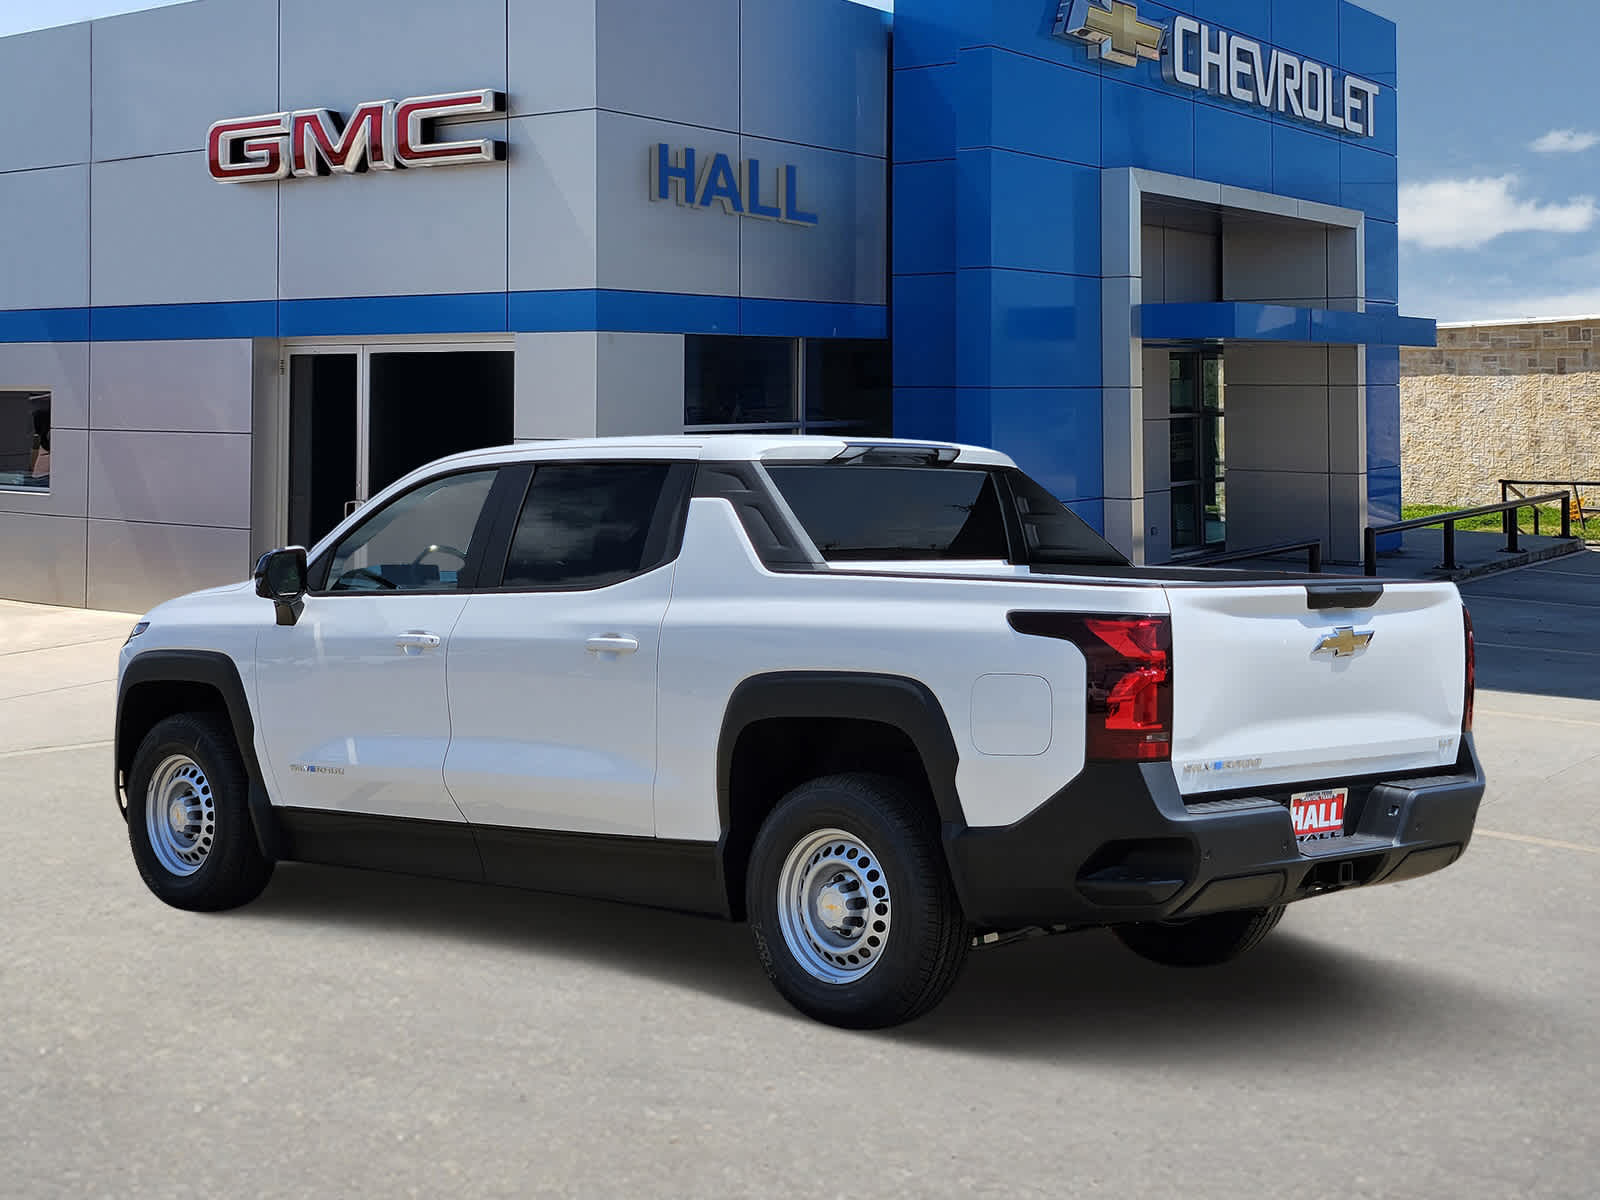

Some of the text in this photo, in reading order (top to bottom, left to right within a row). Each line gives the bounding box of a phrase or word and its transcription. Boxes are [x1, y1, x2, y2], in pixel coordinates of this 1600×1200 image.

[1173, 15, 1379, 137] CHEVROLET
[206, 88, 507, 184] GMC
[650, 142, 818, 227] HALL
[1292, 802, 1343, 831] HALL
